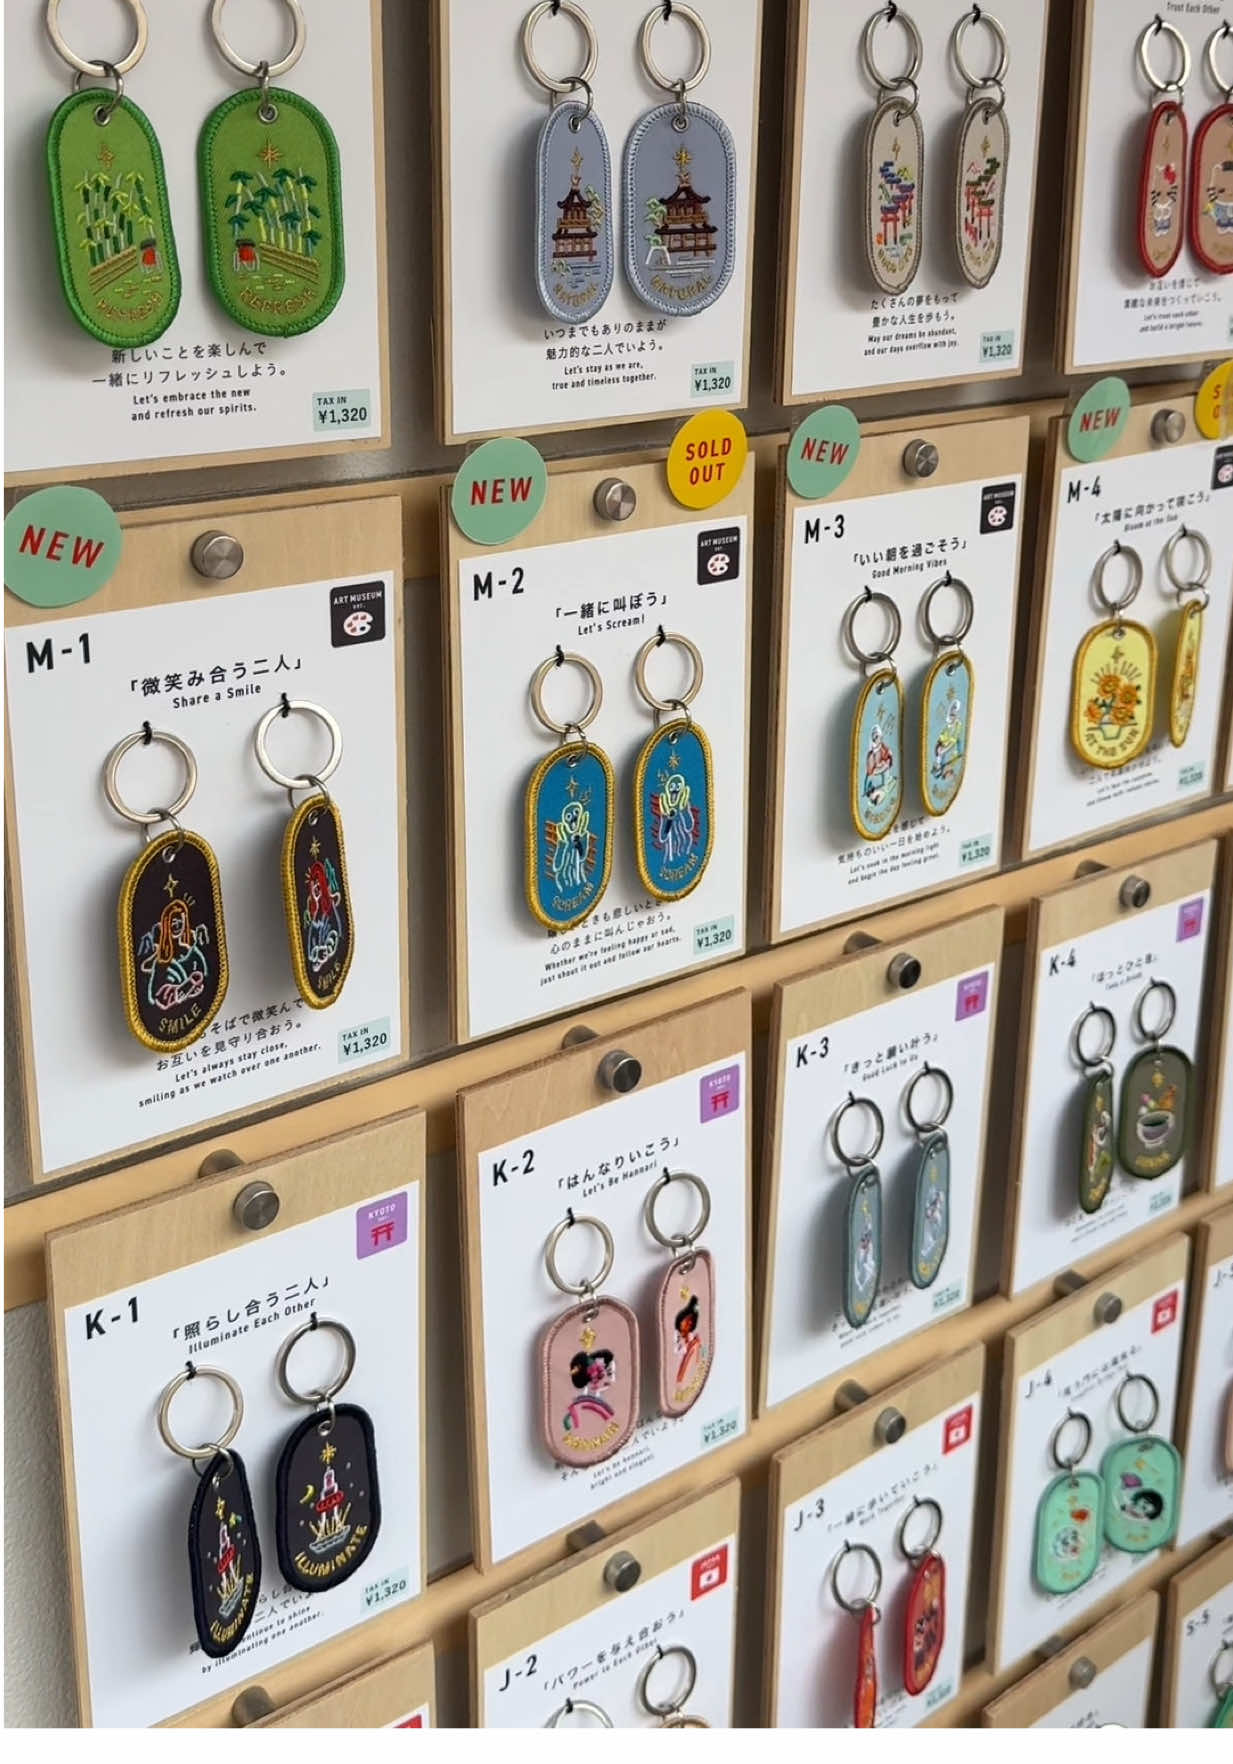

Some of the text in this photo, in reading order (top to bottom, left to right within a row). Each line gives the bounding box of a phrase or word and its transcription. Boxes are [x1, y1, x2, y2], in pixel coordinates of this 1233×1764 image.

[871, 292, 960, 310] たくさんの夢をもって
[544, 320, 666, 340] いつまでもありのままが
[872, 310, 955, 328] 豊かな人生を歩もう。
[546, 340, 663, 360] 魅力的な二人でいよう。
[864, 347, 875, 356] and
[868, 335, 880, 343] May
[895, 332, 917, 340] dreams
[982, 343, 1012, 358] ¥1,320
[111, 341, 266, 364] 新しいことを楽しんで
[92, 362, 287, 388] 一緒にリフレッシュしよう。
[552, 373, 657, 390] true and timeless together.
[564, 366, 583, 376] Let's
[586, 365, 603, 374] stay
[694, 376, 732, 391] ¥1,320
[133, 388, 250, 405] Let's embrace the new
[317, 396, 347, 406] TAX IN
[132, 404, 257, 421] and refresh our spirits.
[318, 407, 368, 424] ¥1,320
[1079, 407, 1121, 433] NEW
[685, 437, 732, 462] SOLD
[801, 437, 850, 466] NEW
[689, 462, 726, 486] OUT
[471, 476, 533, 506] NEW
[1067, 476, 1101, 503] M-4
[701, 536, 737, 547] ART MUSEUM
[804, 514, 845, 544] M-3
[19, 524, 104, 568] NEW
[853, 537, 968, 567] 「いい朝を過ごそう」
[872, 558, 947, 579] Good Morning Vibes
[472, 566, 524, 602] M-2
[334, 591, 382, 606] ART MUSEUM
[555, 591, 668, 620] 「一緒に叫ぼう」
[577, 613, 645, 637] Let's Scream!
[26, 633, 91, 673] M-1
[130, 652, 302, 696] 「微笑み合う二人」
[172, 682, 262, 710] Share a Smile
[1086, 732, 1098, 746] AT
[1096, 746, 1117, 756] THE
[1119, 729, 1139, 751] SUN
[550, 912, 672, 955] 心のままに叫んじゃおう。
[697, 930, 732, 948] ¥1,320
[540, 972, 556, 986] just
[558, 967, 579, 979] shout
[580, 963, 588, 973] it
[590, 960, 601, 970] out
[603, 954, 616, 965] and
[618, 947, 640, 960] follow
[643, 943, 654, 953] our
[544, 956, 576, 972] Whether
[601, 942, 626, 955] feeling
[628, 933, 648, 946] happy
[651, 931, 659, 939] or
[1049, 948, 1076, 976] K-4
[158, 1002, 202, 1035] SMILE
[156, 1020, 302, 1072] お互いを見守り合おう。
[342, 1026, 369, 1040] TAX IN
[343, 1032, 388, 1057] ¥1,320
[175, 1041, 288, 1083] Let's always stay close.
[796, 1036, 829, 1068] K-3
[138, 1043, 321, 1108] smiling as we watch over one another.
[492, 1149, 535, 1187] K-2
[558, 1137, 679, 1190] 「はんなりいこう」
[583, 1159, 658, 1198] Let's Be Hannari
[368, 1203, 396, 1220] KYOTO
[85, 1296, 139, 1341] K-1
[172, 1275, 329, 1342] 「照らし合う二人」
[188, 1299, 316, 1354] Illuminate Each Other
[794, 1498, 825, 1532] J-3
[295, 1524, 368, 1577] ILLUMINATE
[366, 1579, 407, 1607] ¥1,320
[210, 1571, 254, 1644] ILLUMINATE
[276, 1606, 311, 1627] to shine
[202, 1665, 212, 1673] by
[215, 1639, 269, 1667] illuminating
[271, 1629, 286, 1641] one
[544, 1610, 685, 1691] 「パワーを与え合おう」
[499, 1654, 538, 1692] J-2
